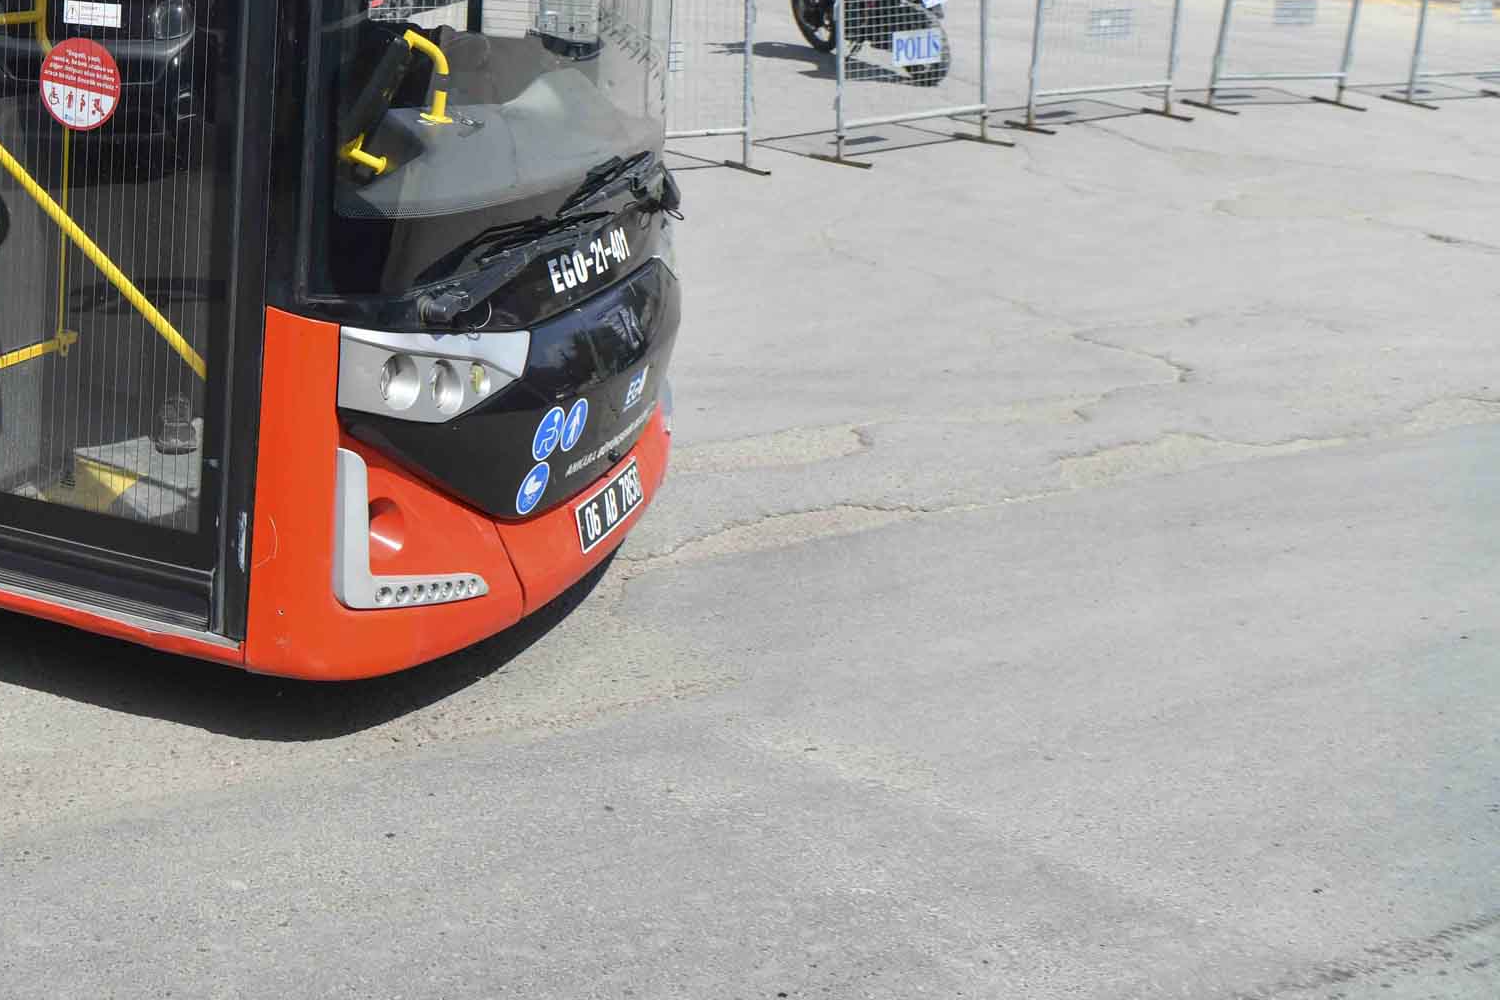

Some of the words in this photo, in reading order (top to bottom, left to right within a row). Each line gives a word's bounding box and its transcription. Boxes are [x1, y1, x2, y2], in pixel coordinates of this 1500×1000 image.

[548, 226, 631, 293] EGO-21-401
[585, 506, 601, 541] 06
[604, 486, 618, 527] AB
